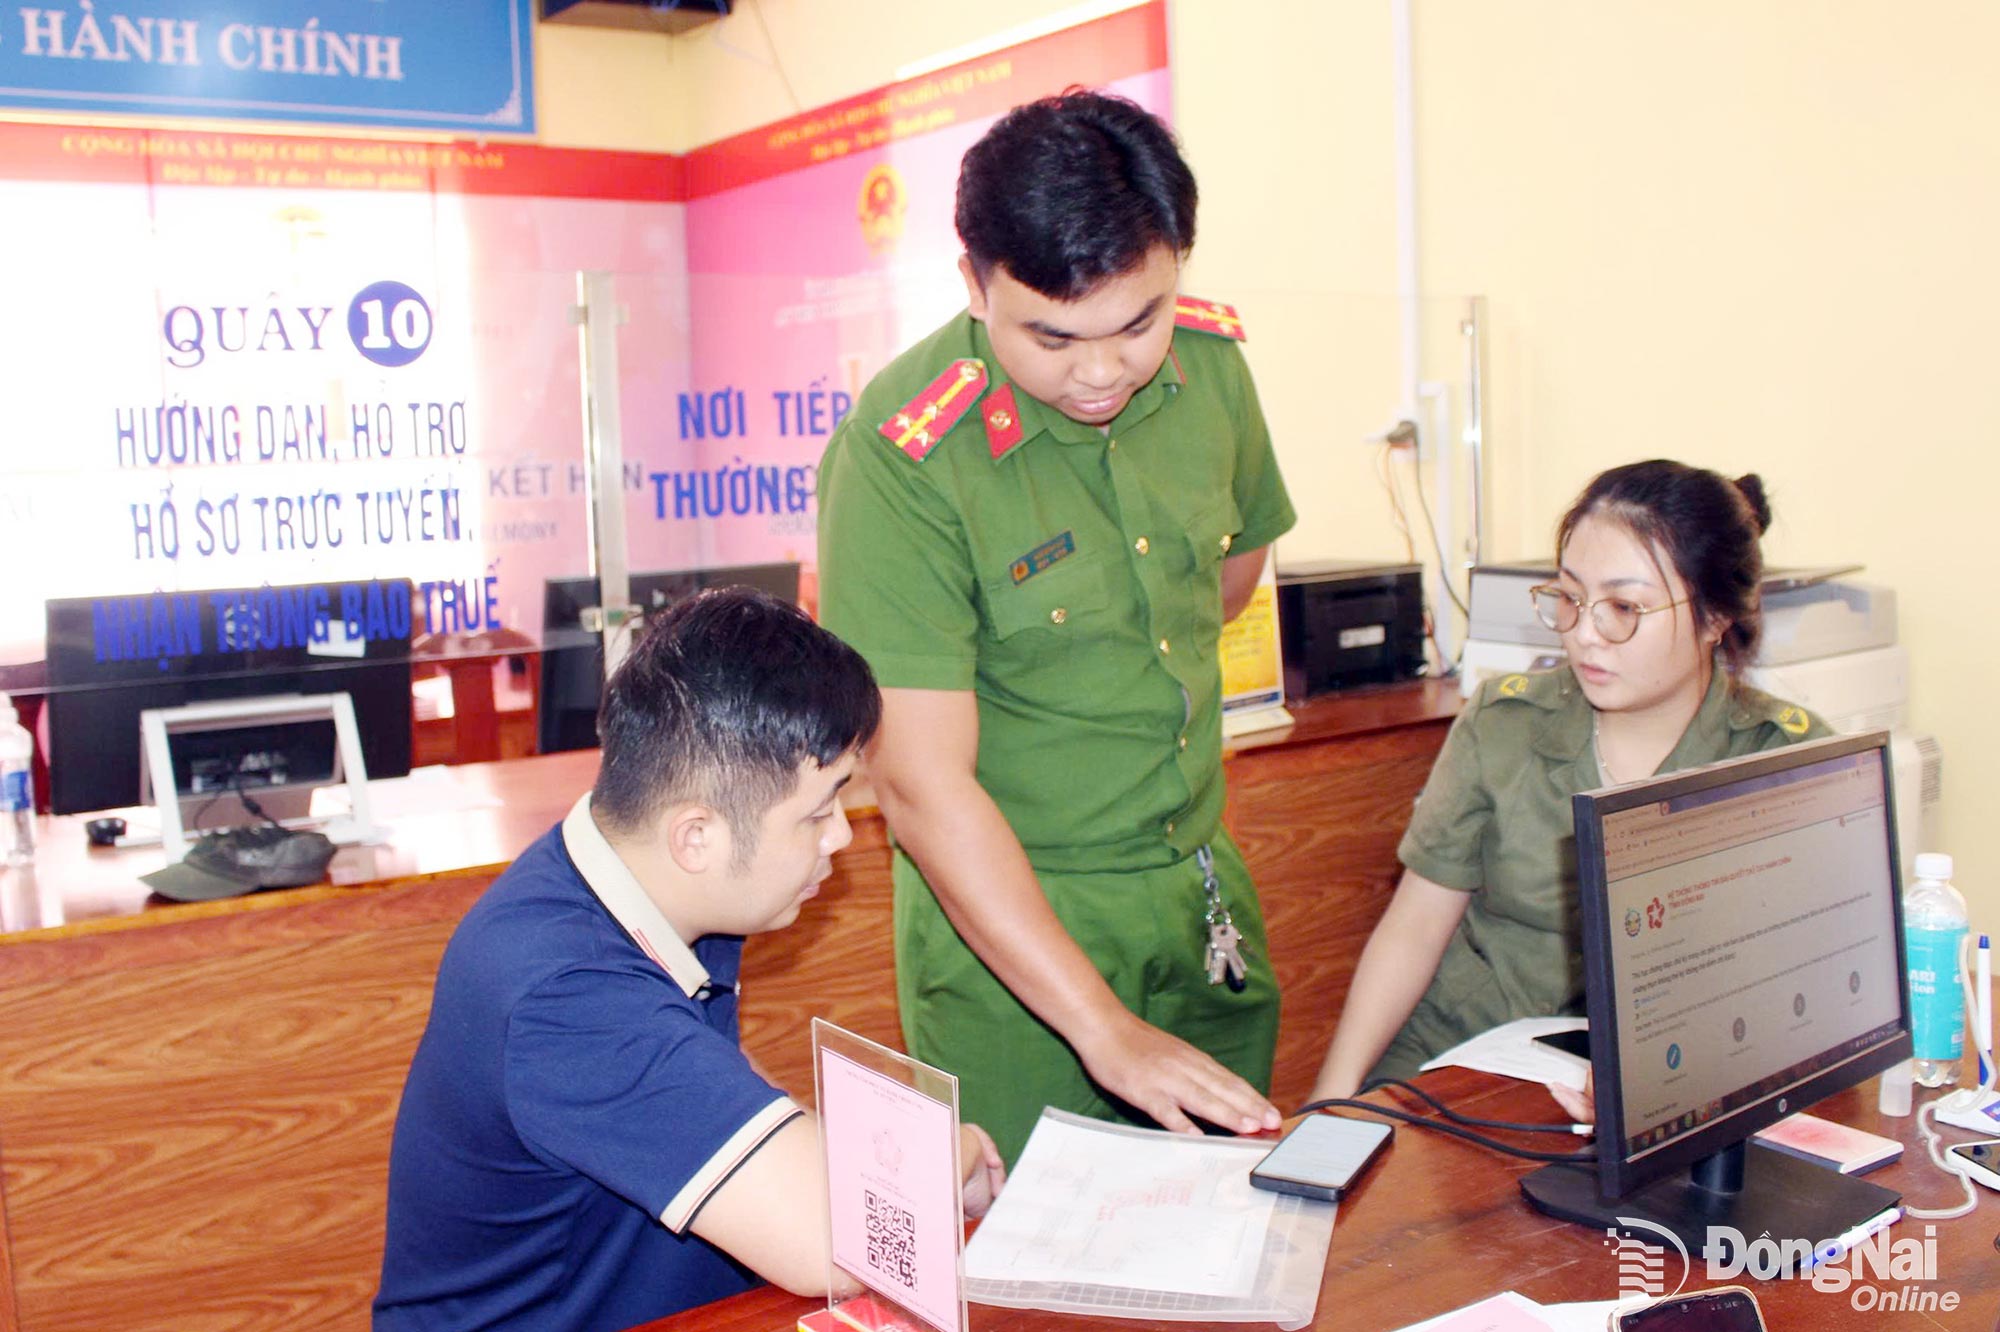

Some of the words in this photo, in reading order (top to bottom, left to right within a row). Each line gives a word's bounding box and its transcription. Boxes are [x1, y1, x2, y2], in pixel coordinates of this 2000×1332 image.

[20, 0, 201, 66] HÀNH
[218, 16, 404, 81] CHÍNH
[361, 299, 429, 349] 10
[678, 386, 745, 440] NƠI
[773, 376, 851, 437] TIẾP
[569, 461, 643, 493] HN
[649, 456, 807, 519] THƯỜNG
[195, 493, 239, 556] SƠ
[93, 587, 203, 672] NHẬN
[210, 579, 329, 654] THÔNG
[420, 557, 501, 635] THUẾ
